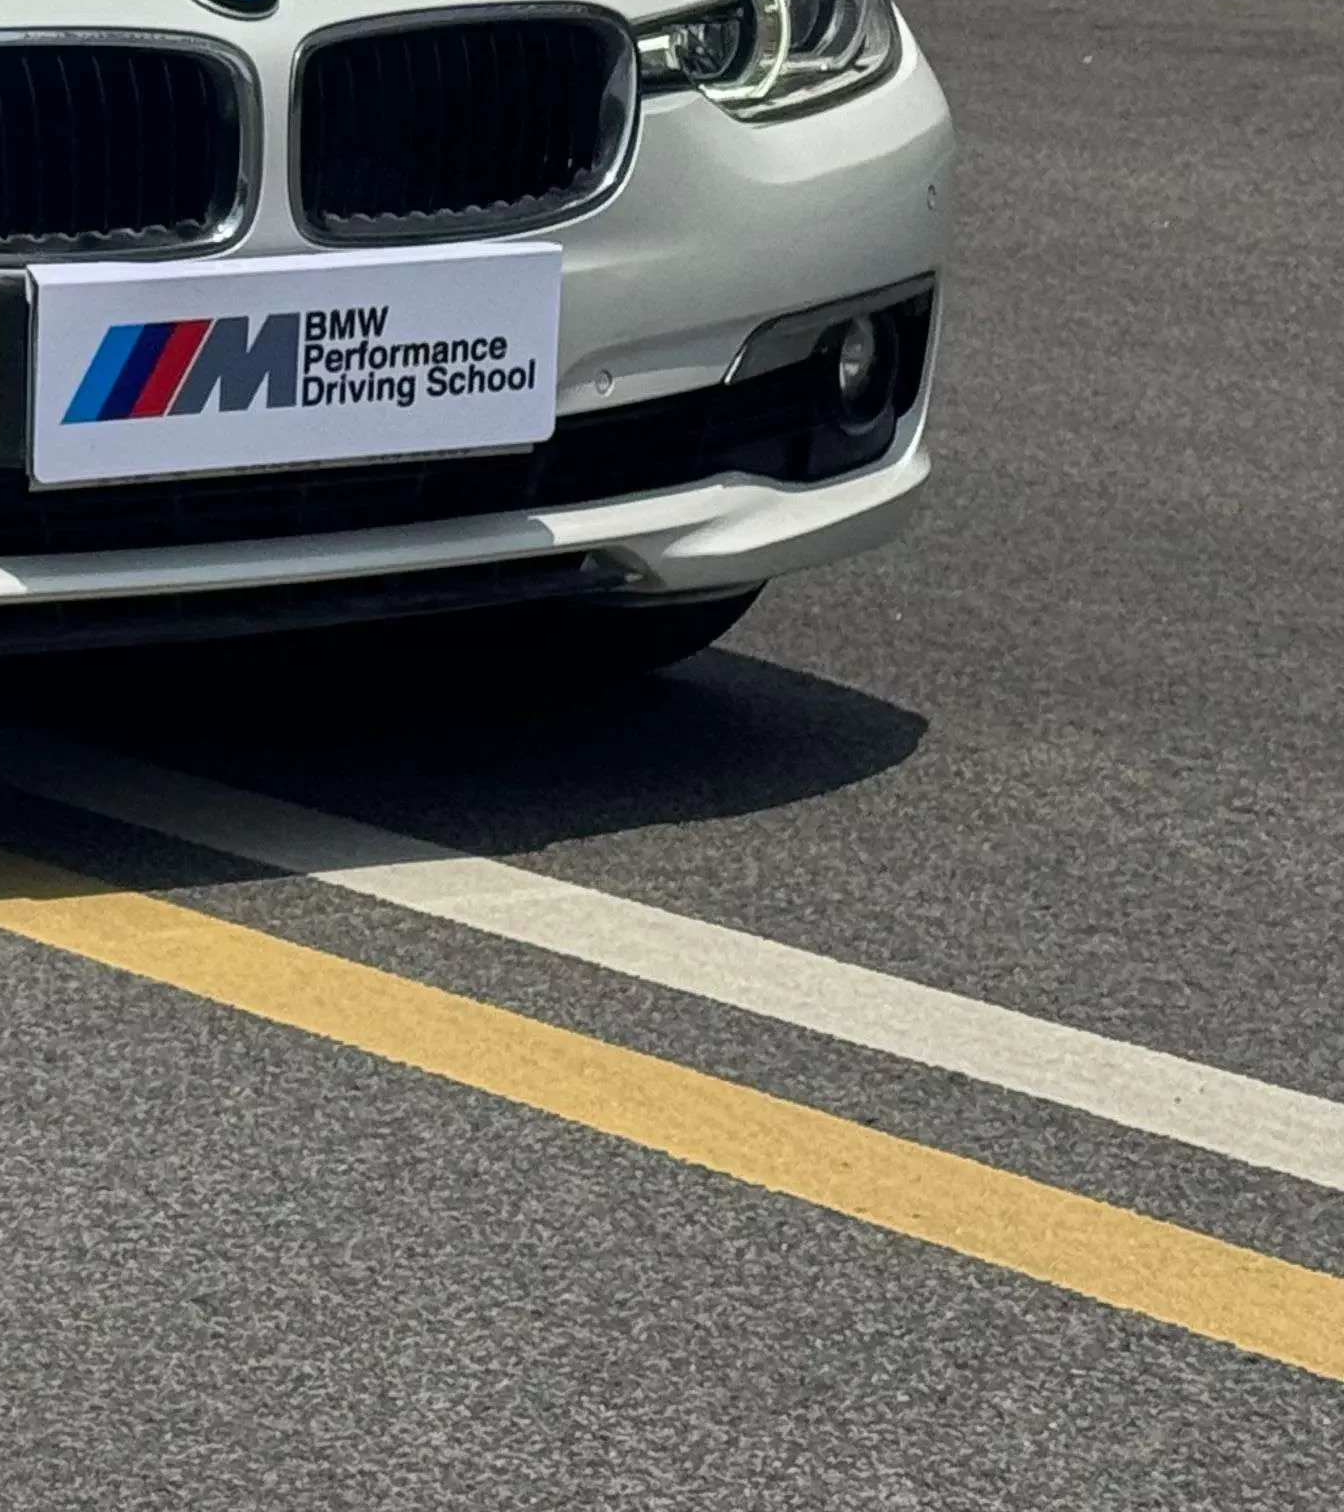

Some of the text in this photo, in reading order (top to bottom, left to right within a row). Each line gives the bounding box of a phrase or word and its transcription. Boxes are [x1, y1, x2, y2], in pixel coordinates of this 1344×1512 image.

[305, 306, 389, 341] BMW
[304, 337, 508, 374] Performance
[302, 358, 535, 407] Driving School
